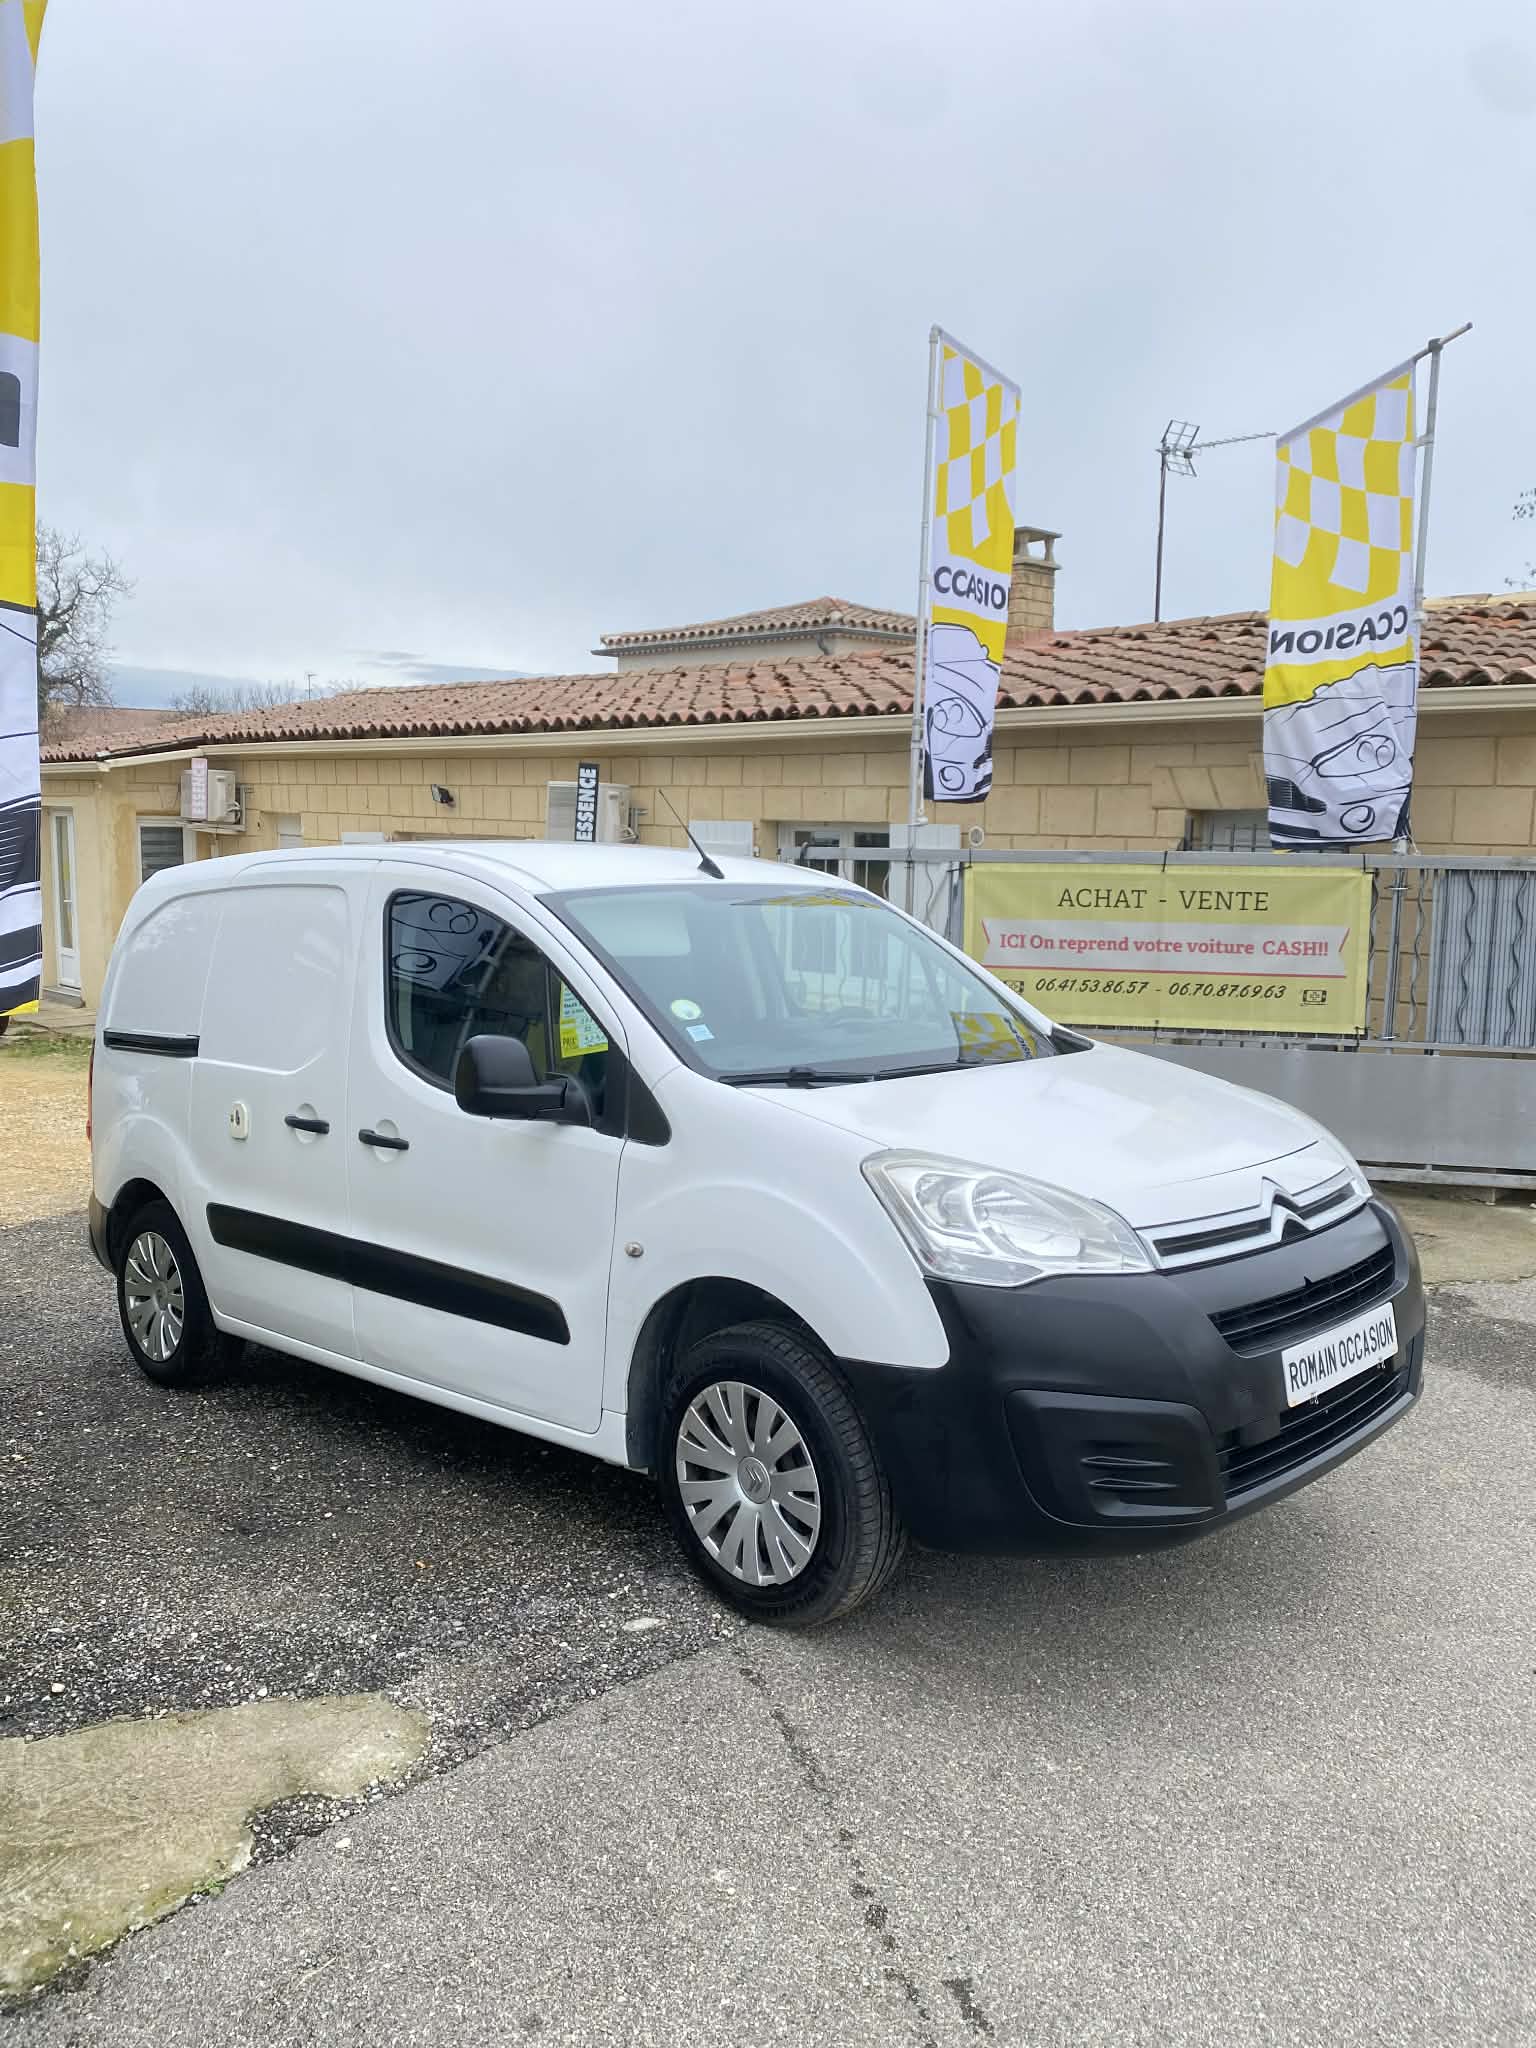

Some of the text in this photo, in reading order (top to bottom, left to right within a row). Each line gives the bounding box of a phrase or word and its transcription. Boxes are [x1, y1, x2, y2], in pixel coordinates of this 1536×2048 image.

[934, 566, 1011, 609] CCASIO
[576, 768, 597, 841] ESSENCE
[1057, 888, 1148, 909] ACHAT
[1178, 890, 1270, 911] VENTE
[1000, 933, 1329, 957] ICI On reprend votre voiture CASH!!
[1035, 977, 1150, 994] 06.41.53.86.57
[1168, 982, 1288, 999] 06.70.87.69.63
[1288, 1317, 1394, 1393] ROMAIN OCCASION
